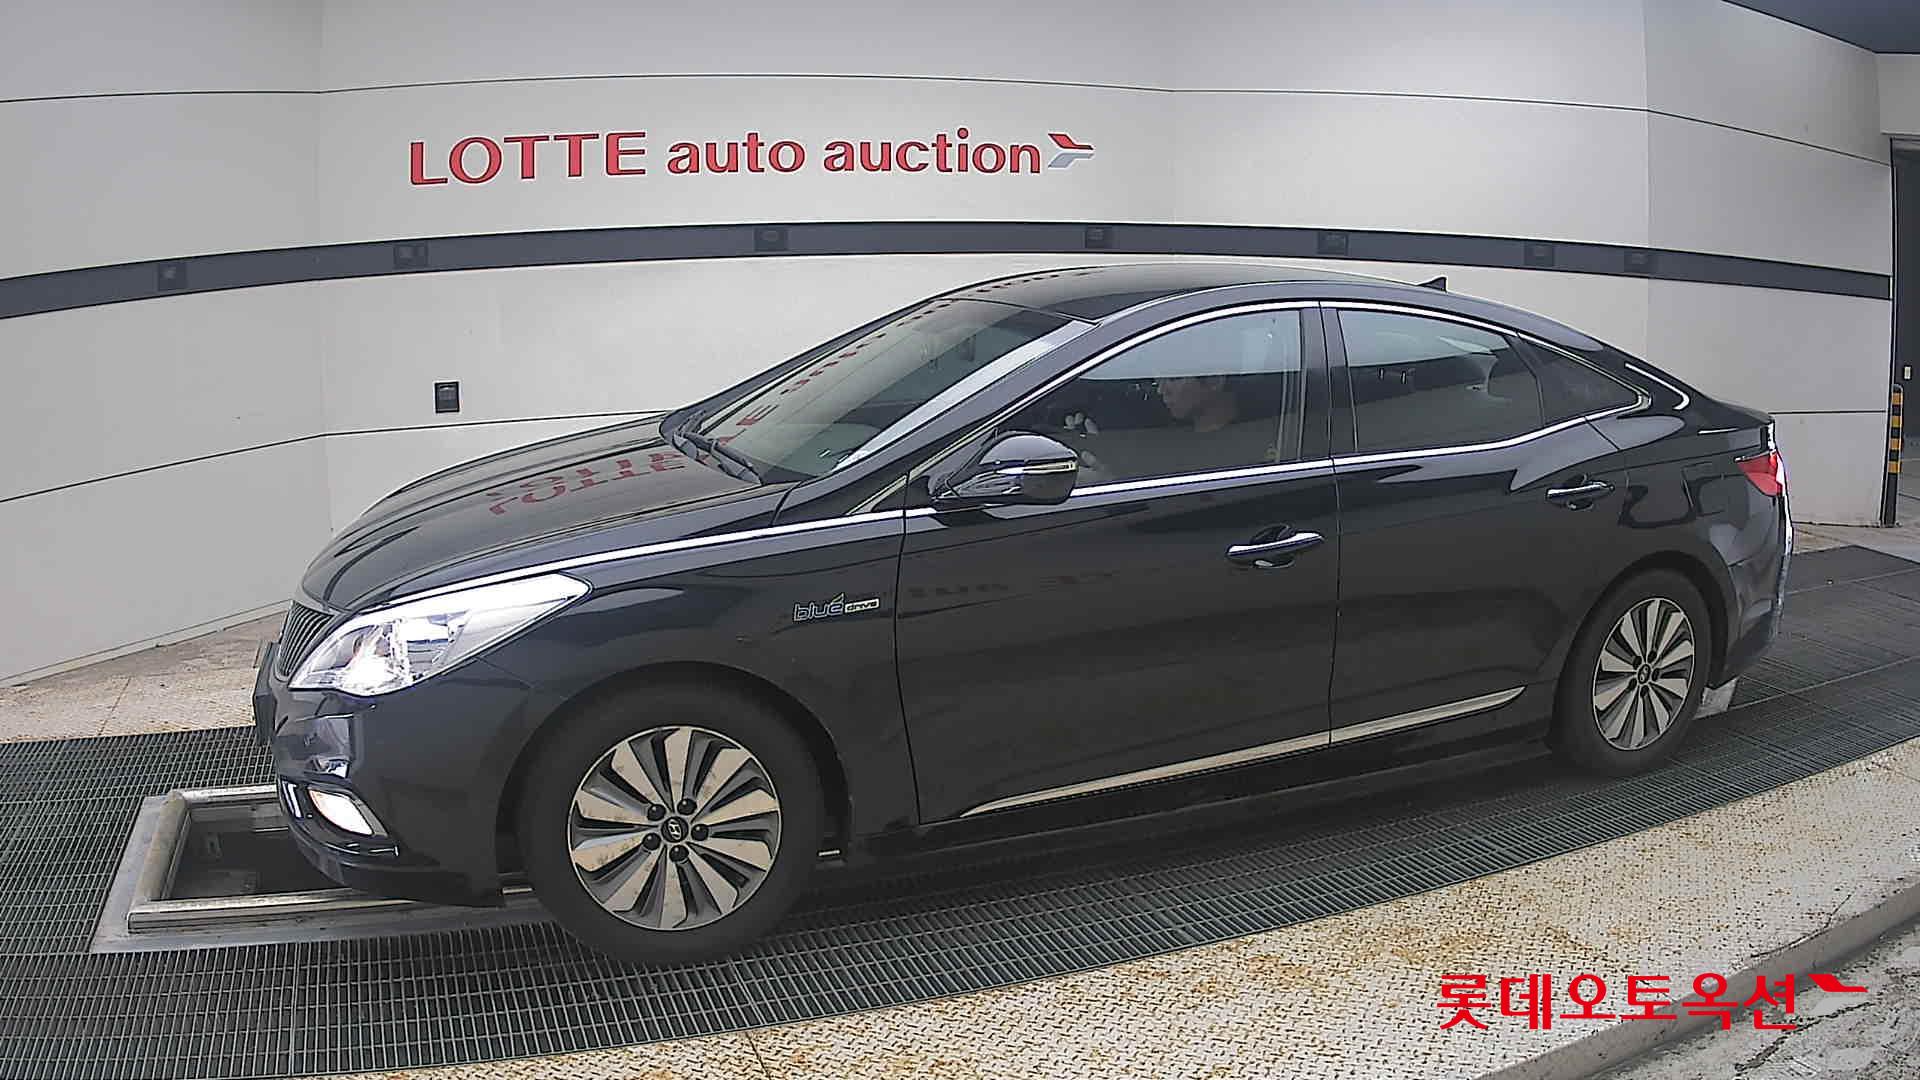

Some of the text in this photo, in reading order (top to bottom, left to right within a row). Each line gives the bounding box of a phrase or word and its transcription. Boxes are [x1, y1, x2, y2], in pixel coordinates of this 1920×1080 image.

[409, 127, 1041, 185] LOTTE auto auction
[793, 594, 844, 621] blue
